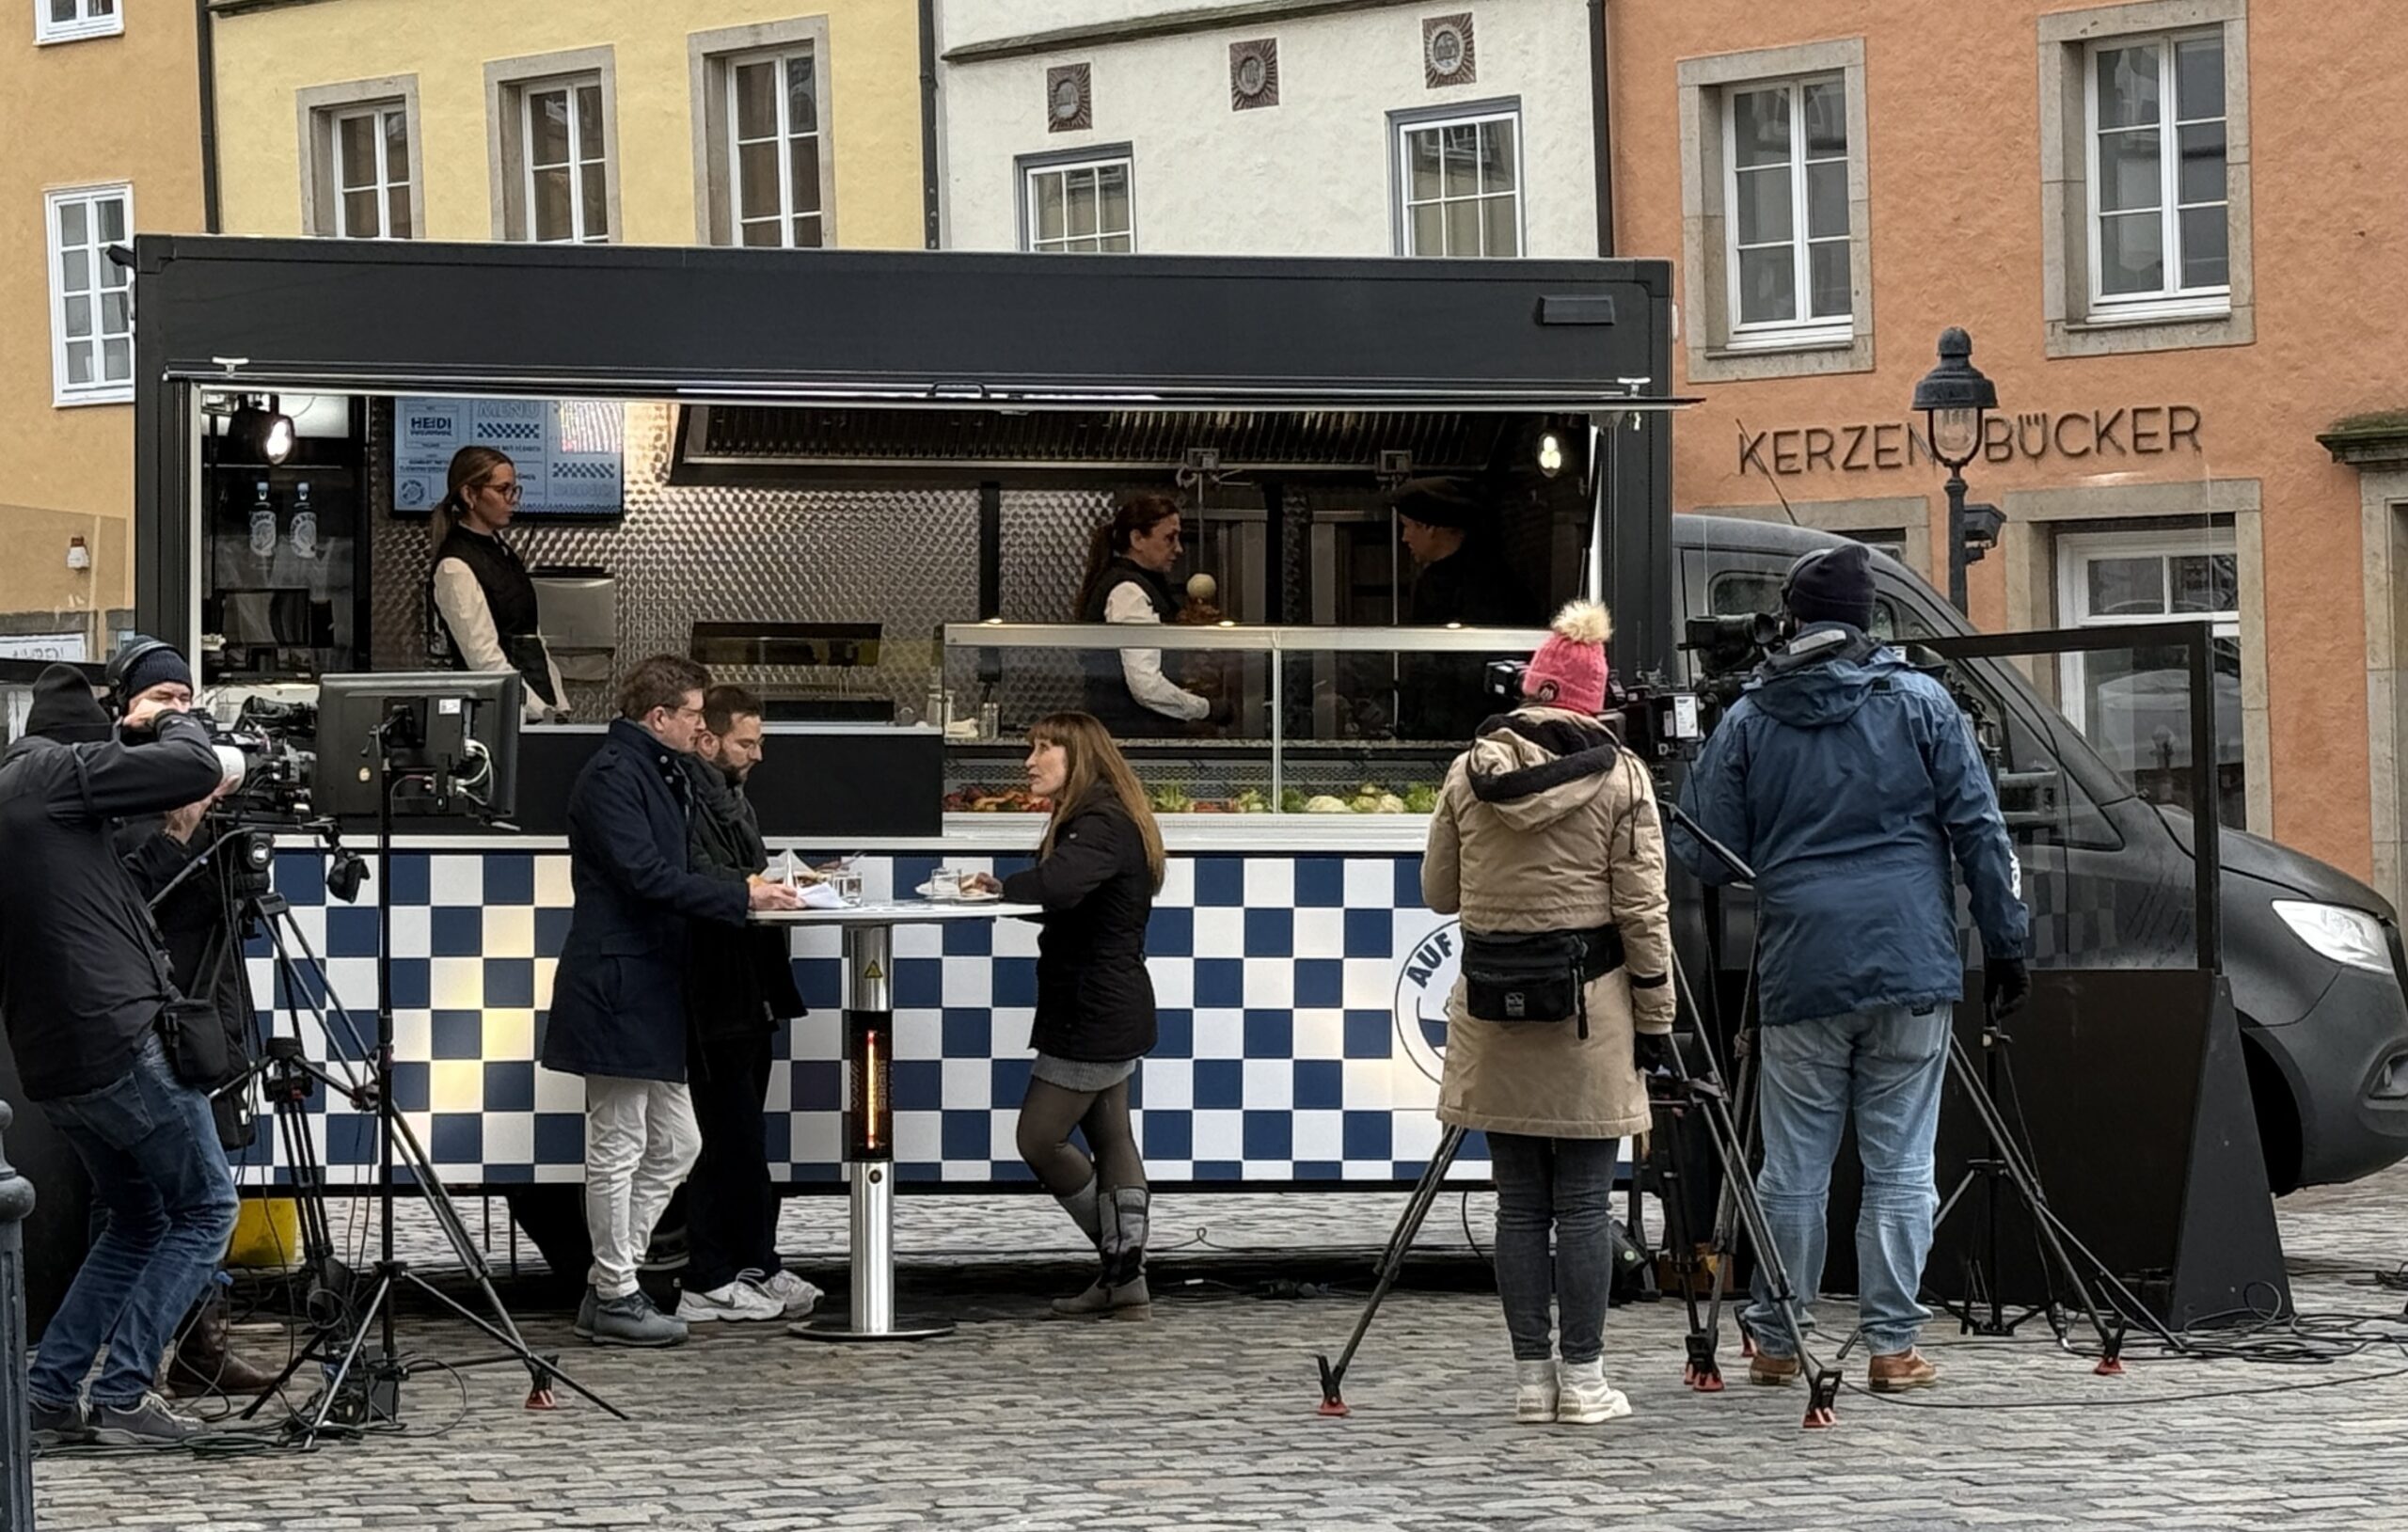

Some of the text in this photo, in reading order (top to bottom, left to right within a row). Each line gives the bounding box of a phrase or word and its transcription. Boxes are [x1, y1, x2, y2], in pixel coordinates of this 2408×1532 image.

[411, 417, 452, 430] HEIDI
[1738, 404, 2203, 475] KERZEN BÜCKER
[1406, 931, 1454, 989] AUF
